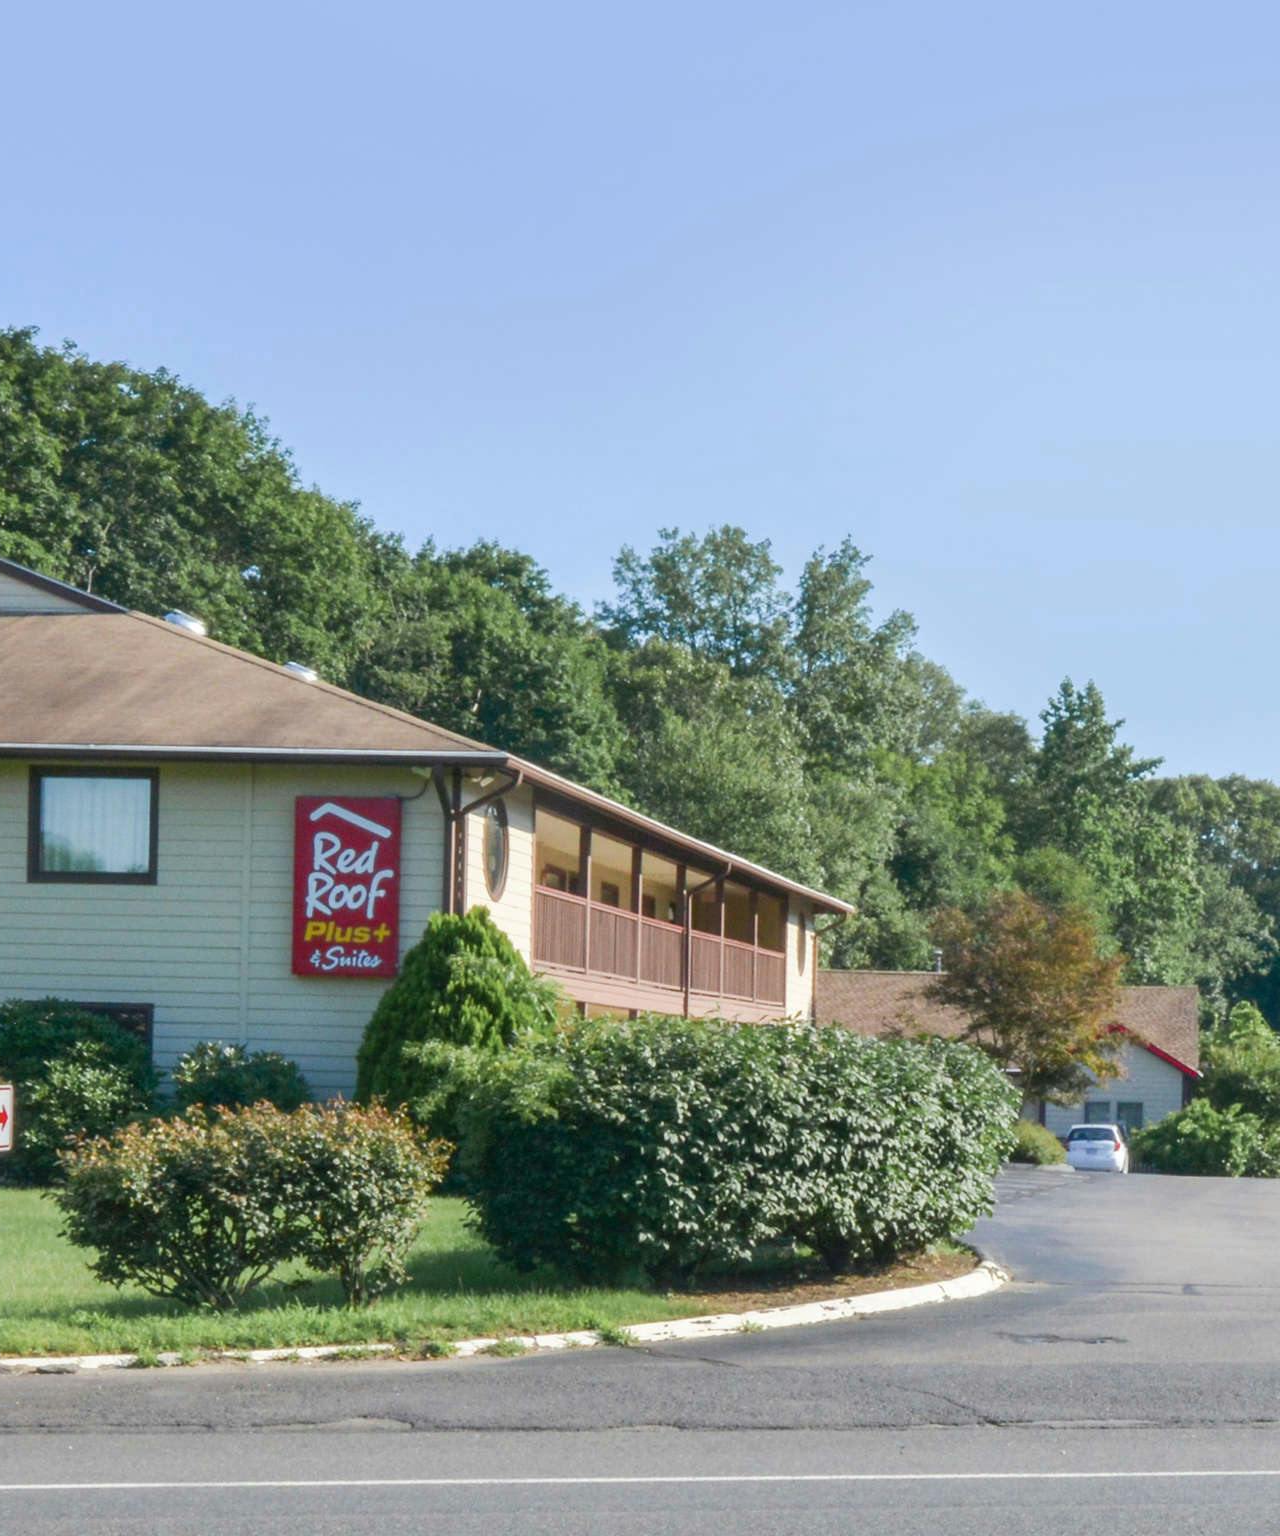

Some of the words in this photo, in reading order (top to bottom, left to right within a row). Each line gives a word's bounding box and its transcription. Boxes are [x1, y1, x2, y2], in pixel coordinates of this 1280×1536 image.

[313, 831, 379, 875] Red
[305, 869, 394, 919] Roof
[309, 949, 321, 968] &
[321, 946, 382, 971] Suites
